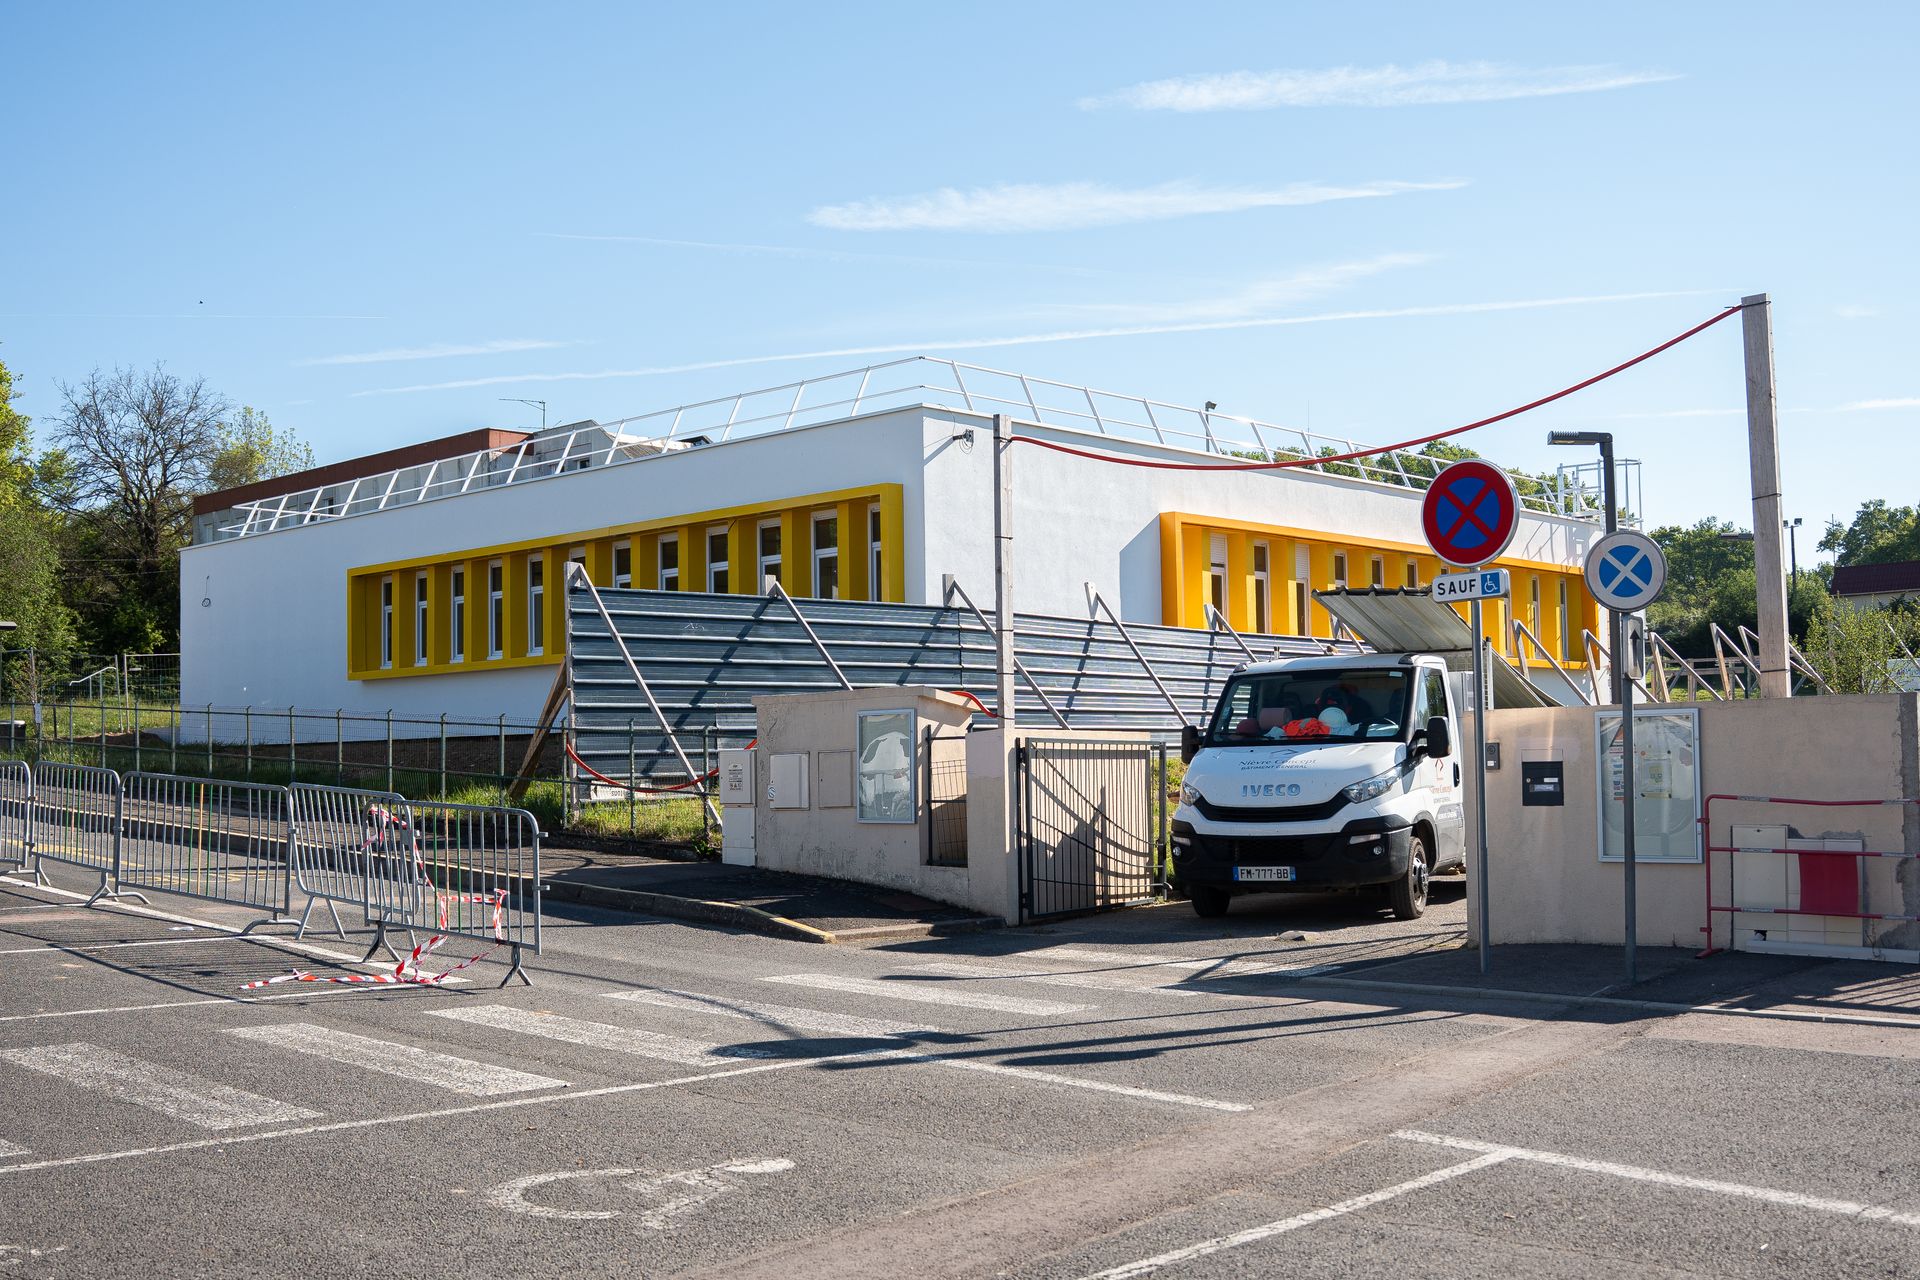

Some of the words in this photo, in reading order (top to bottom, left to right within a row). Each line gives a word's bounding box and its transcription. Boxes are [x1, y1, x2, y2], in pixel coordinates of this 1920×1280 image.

[1437, 578, 1476, 596] SAUF
[1241, 783, 1301, 798] IVECO
[1240, 868, 1289, 879] FM-777-BB
